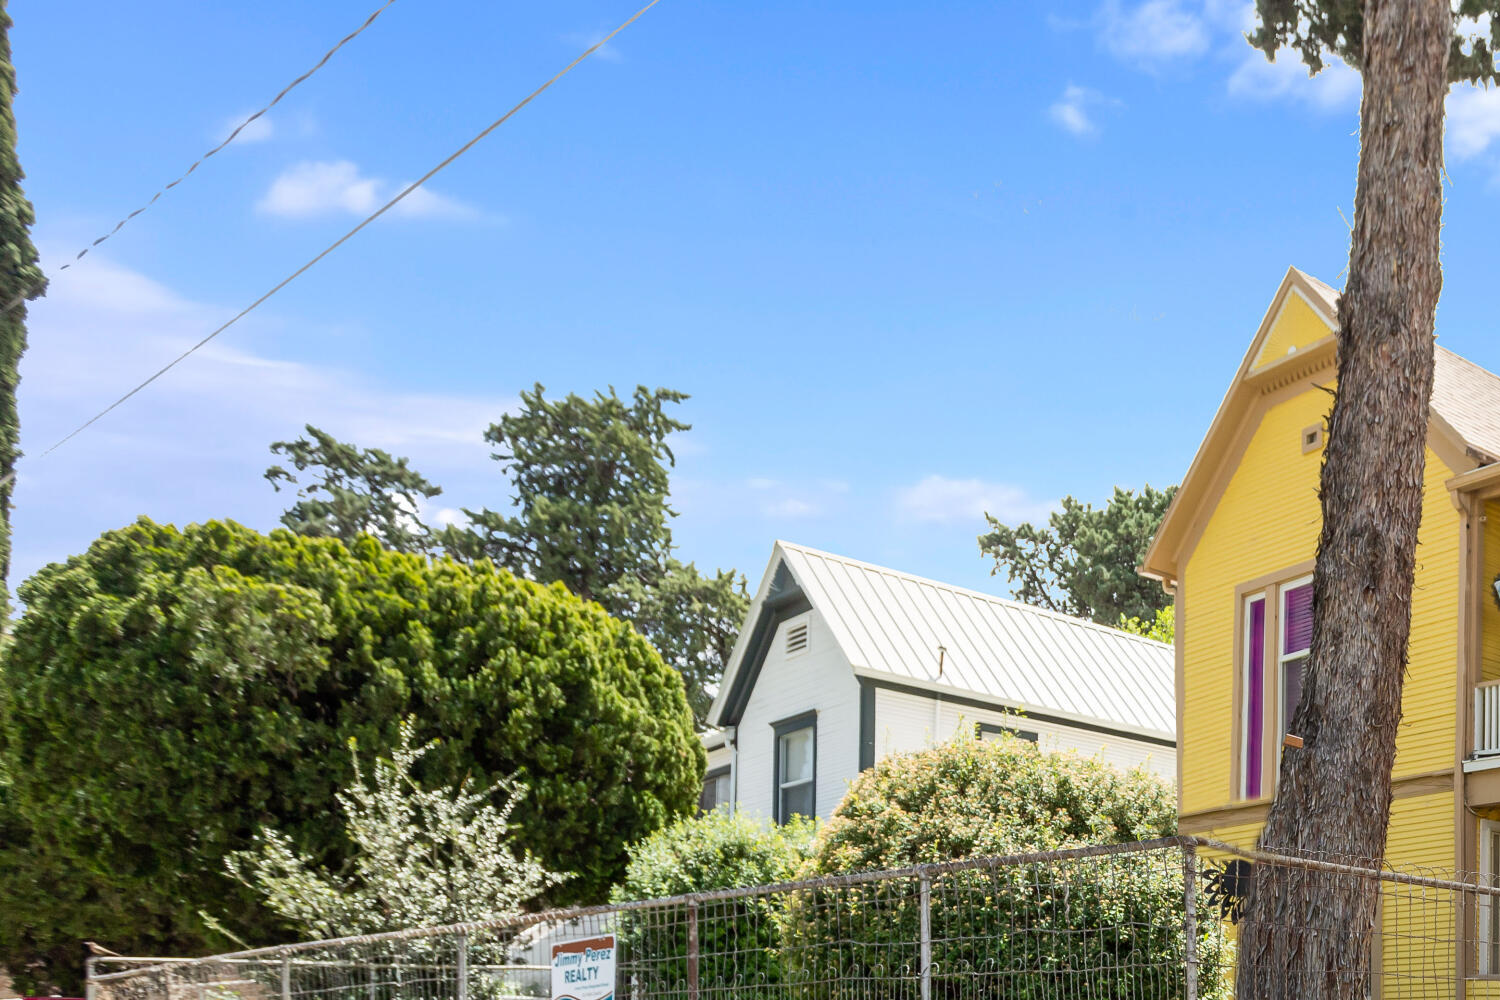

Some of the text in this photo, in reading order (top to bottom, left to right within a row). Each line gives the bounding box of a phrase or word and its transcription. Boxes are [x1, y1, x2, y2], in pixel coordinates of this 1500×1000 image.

[555, 949, 610, 967] Jimmy Perez
[564, 966, 598, 982] REALTY
